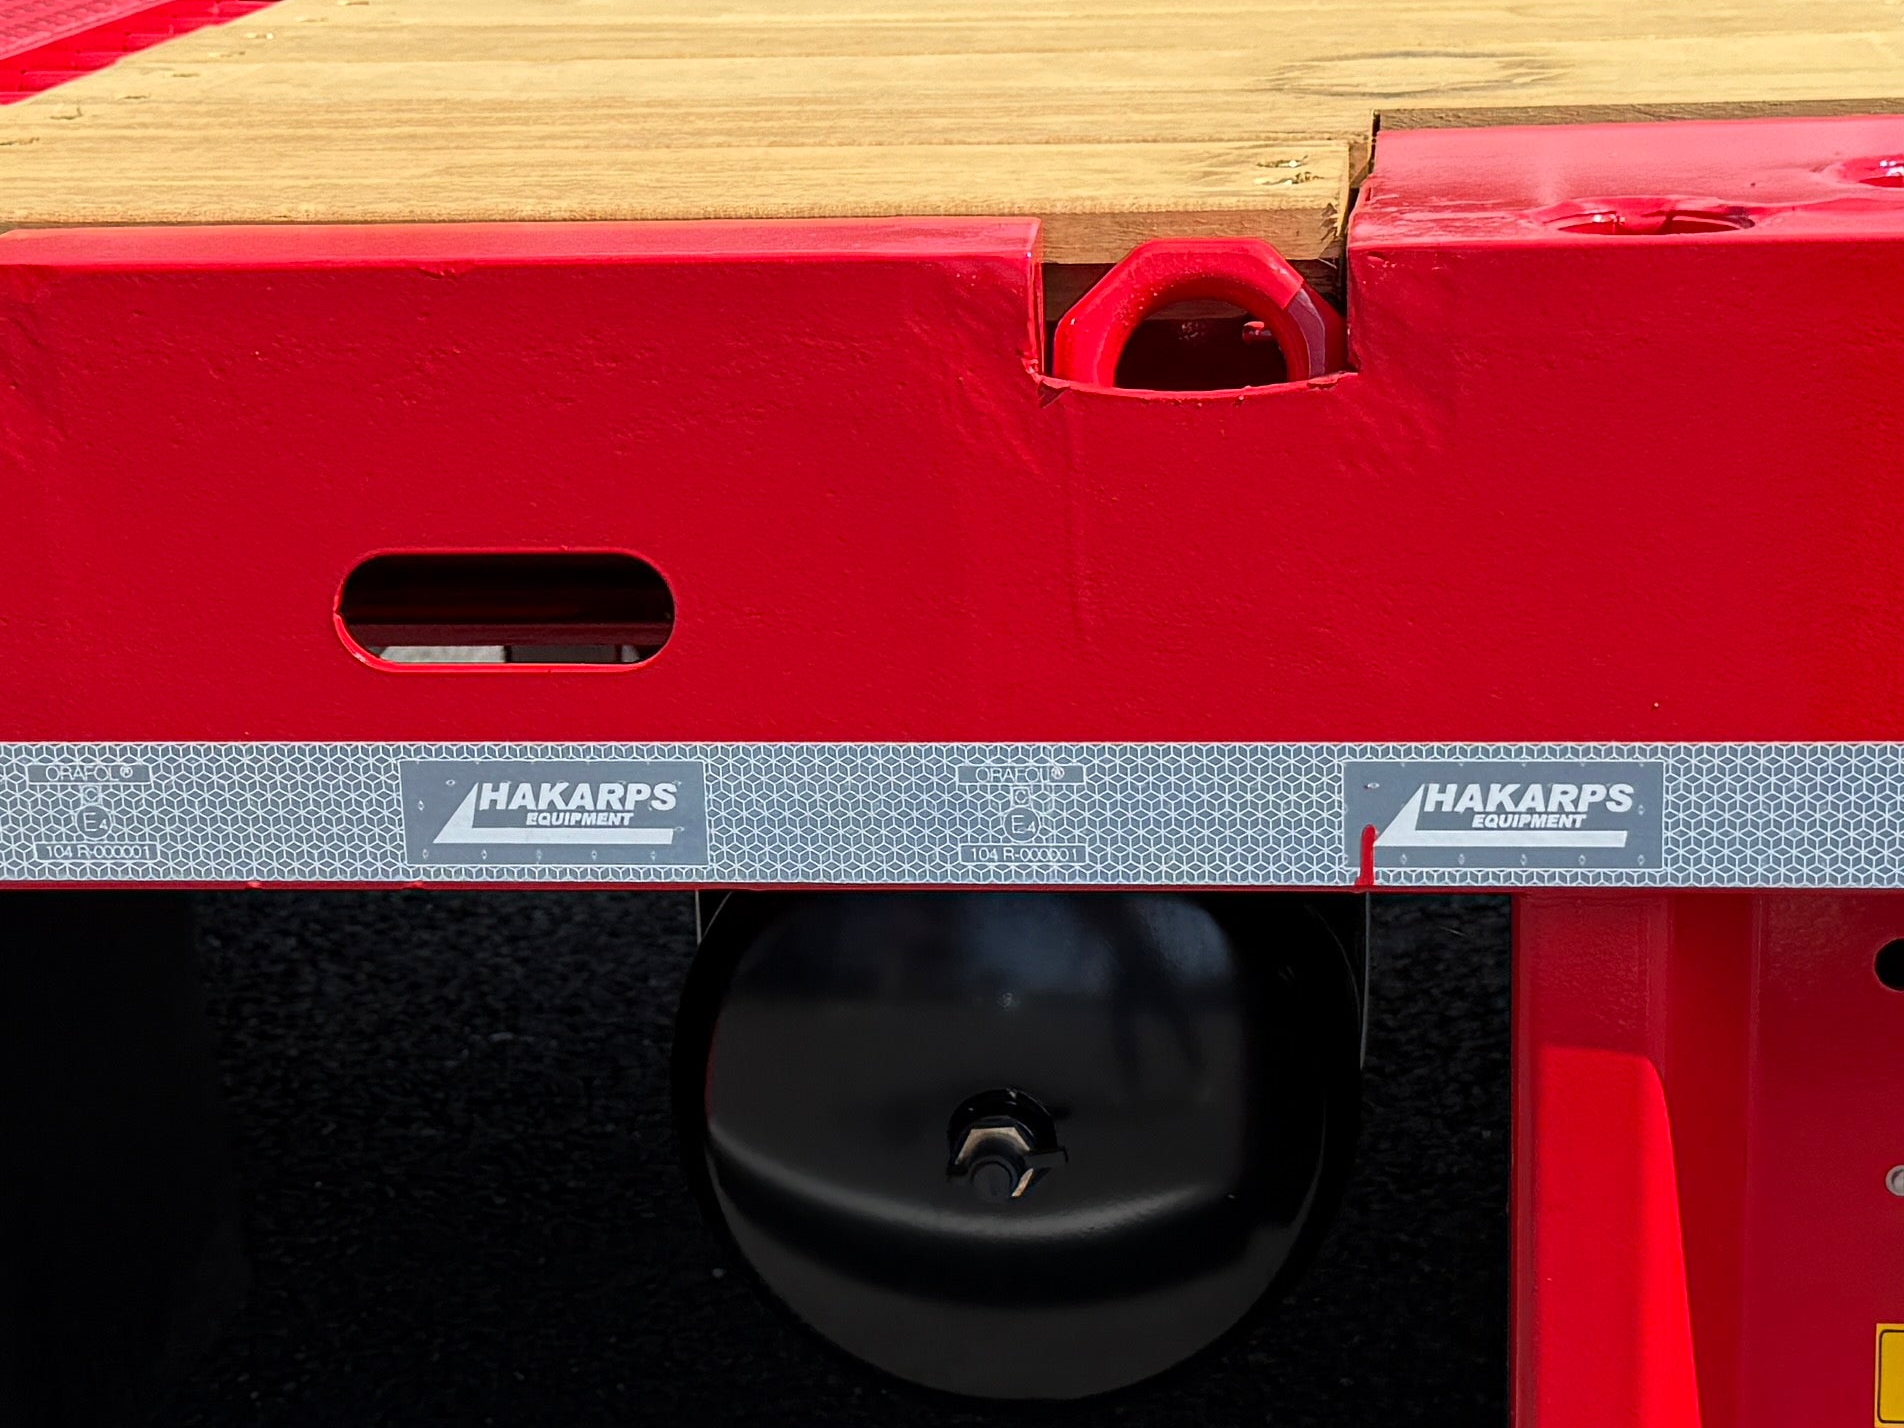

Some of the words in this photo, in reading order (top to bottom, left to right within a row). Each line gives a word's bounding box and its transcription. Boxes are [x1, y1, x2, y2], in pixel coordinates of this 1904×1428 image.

[478, 781, 678, 811] HAKARPS
[1422, 782, 1635, 813] HAKARPS
[524, 810, 634, 826] EQUIPMENT
[1471, 813, 1587, 828] EQUIPMENT
